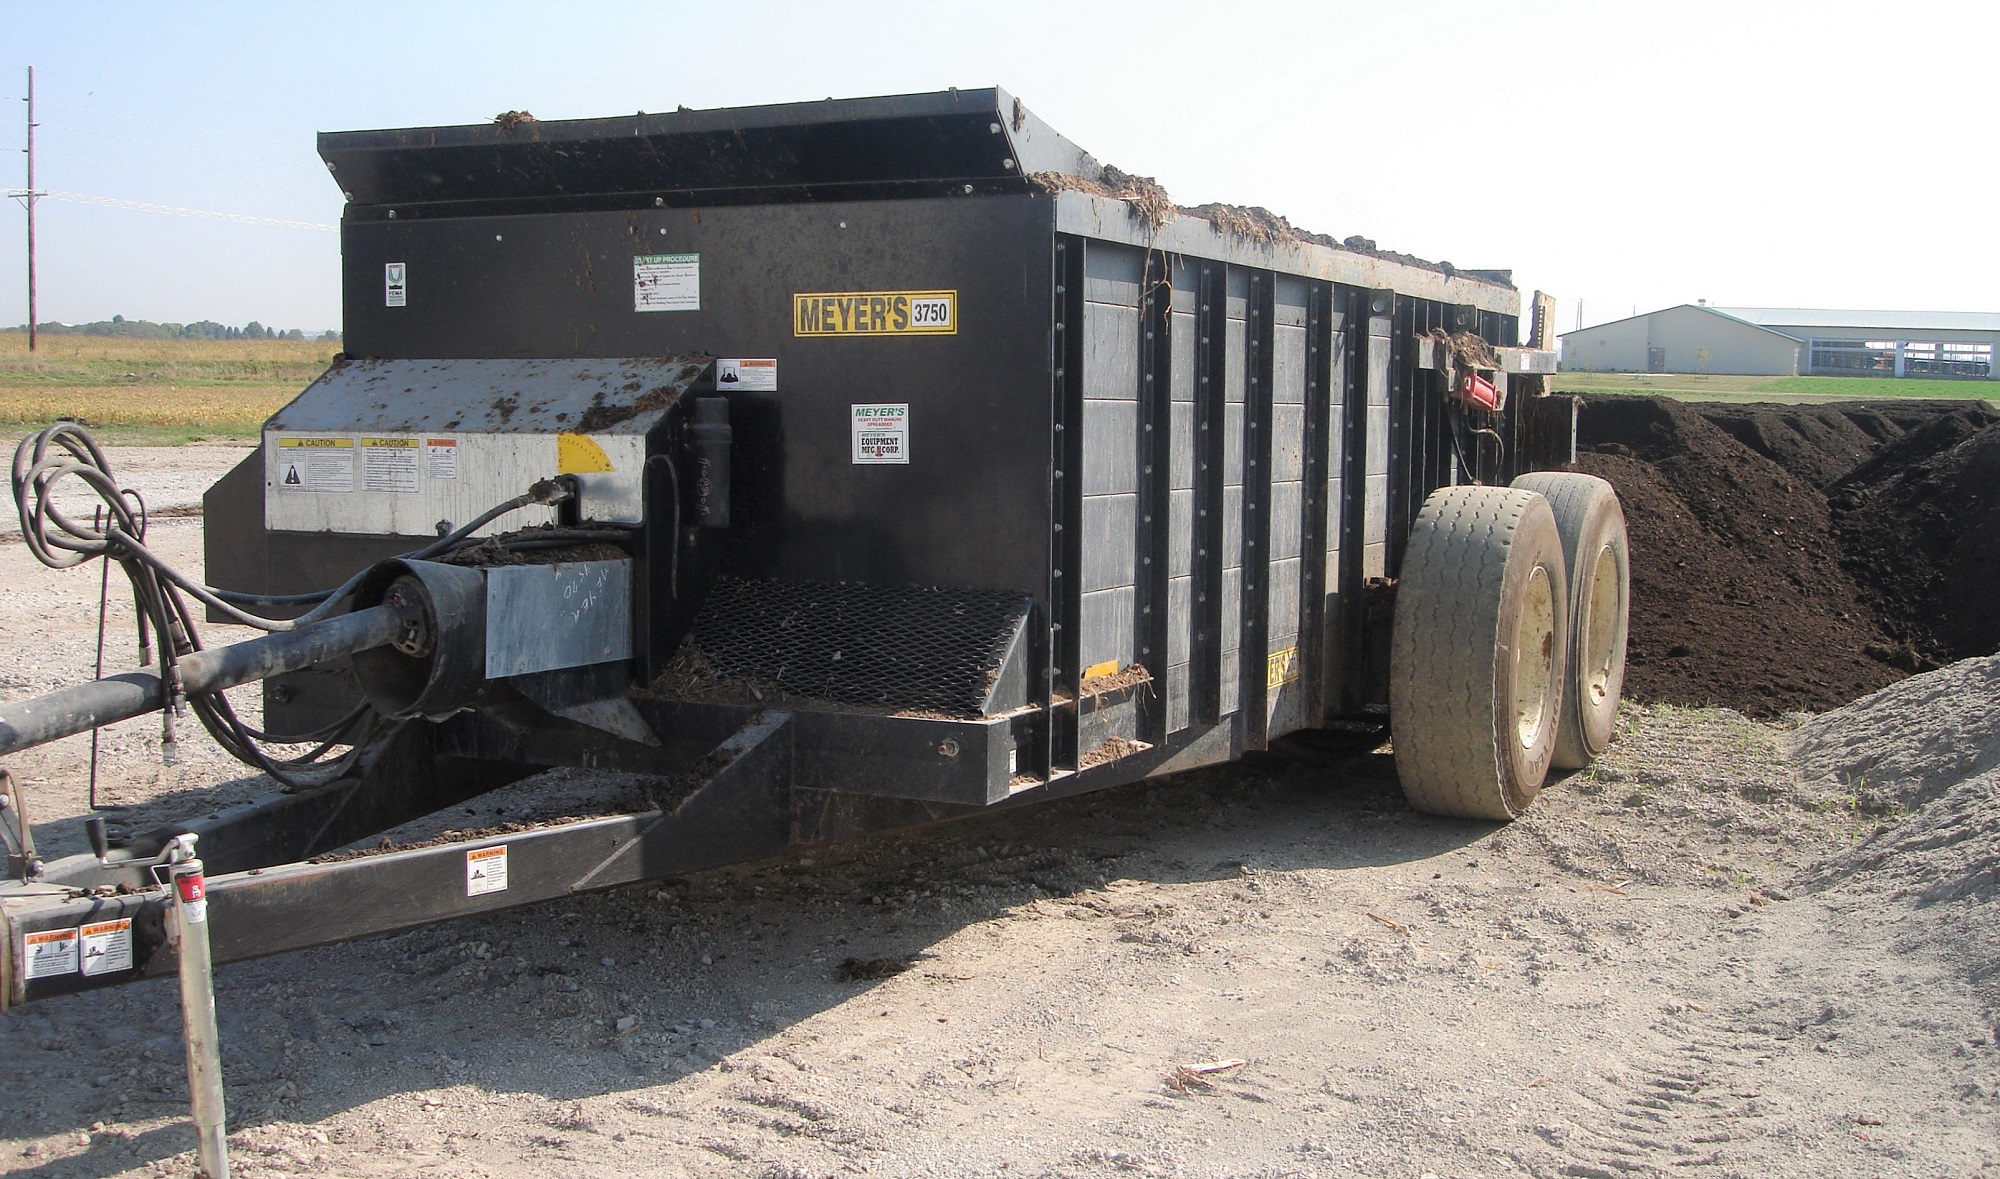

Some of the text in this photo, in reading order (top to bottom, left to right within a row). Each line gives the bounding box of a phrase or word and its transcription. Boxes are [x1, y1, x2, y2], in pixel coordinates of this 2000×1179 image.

[663, 255, 699, 263] PROCEDURE
[800, 296, 947, 332] MEYER'S 3750
[855, 407, 905, 417] MEYER'S
[305, 439, 336, 447] CAUTION
[379, 439, 409, 447] CAUTION
[861, 437, 899, 446] EQUIPMENT
[477, 848, 504, 858] WARNING
[93, 921, 129, 933] WARNING
[38, 931, 73, 942] WARNING
